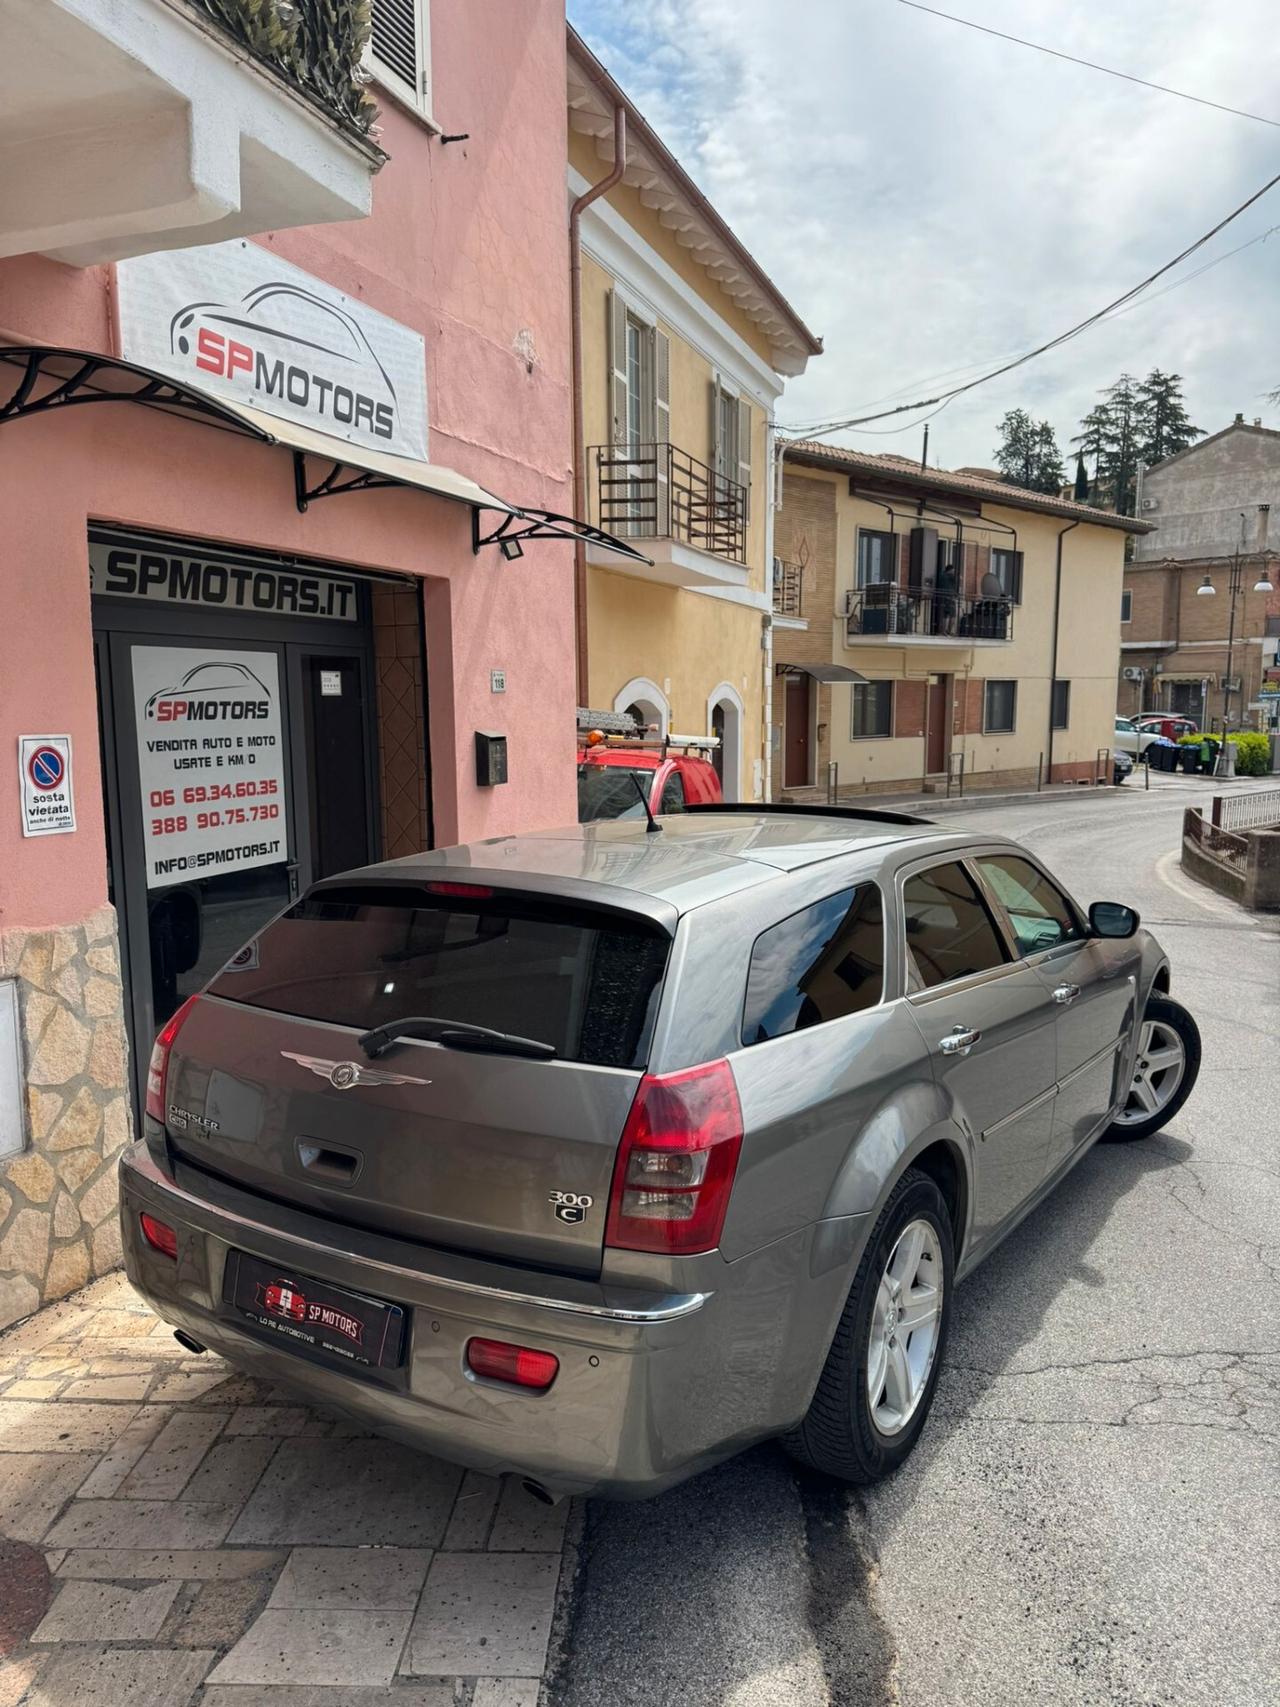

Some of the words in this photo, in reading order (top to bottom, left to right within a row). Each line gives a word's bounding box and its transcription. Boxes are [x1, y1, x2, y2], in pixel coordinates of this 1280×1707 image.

[106, 551, 353, 617] SPMOTORS.IT
[157, 701, 269, 721] SPMOTORS
[147, 739, 198, 752] VENDITA
[203, 738, 232, 749] AUTO
[237, 737, 243, 747] E
[248, 736, 276, 747] MOTO
[174, 757, 212, 770] USATE
[217, 756, 223, 766] E
[33, 793, 65, 804] sosta
[150, 790, 175, 808] 06
[183, 779, 278, 803] 69.34.60.35
[28, 804, 69, 816] vietata
[152, 816, 187, 836] 388
[197, 804, 279, 829] 90.75.730
[154, 840, 280, 875] INFO@SPMOTORS.IT
[169, 1104, 220, 1130] CHRYSLER
[548, 1190, 593, 1208] 300
[560, 1208, 577, 1221] C
[308, 1305, 321, 1320] SP
[322, 1309, 358, 1337] MOTORS
[277, 1324, 315, 1344] AUTOMOTIVE
